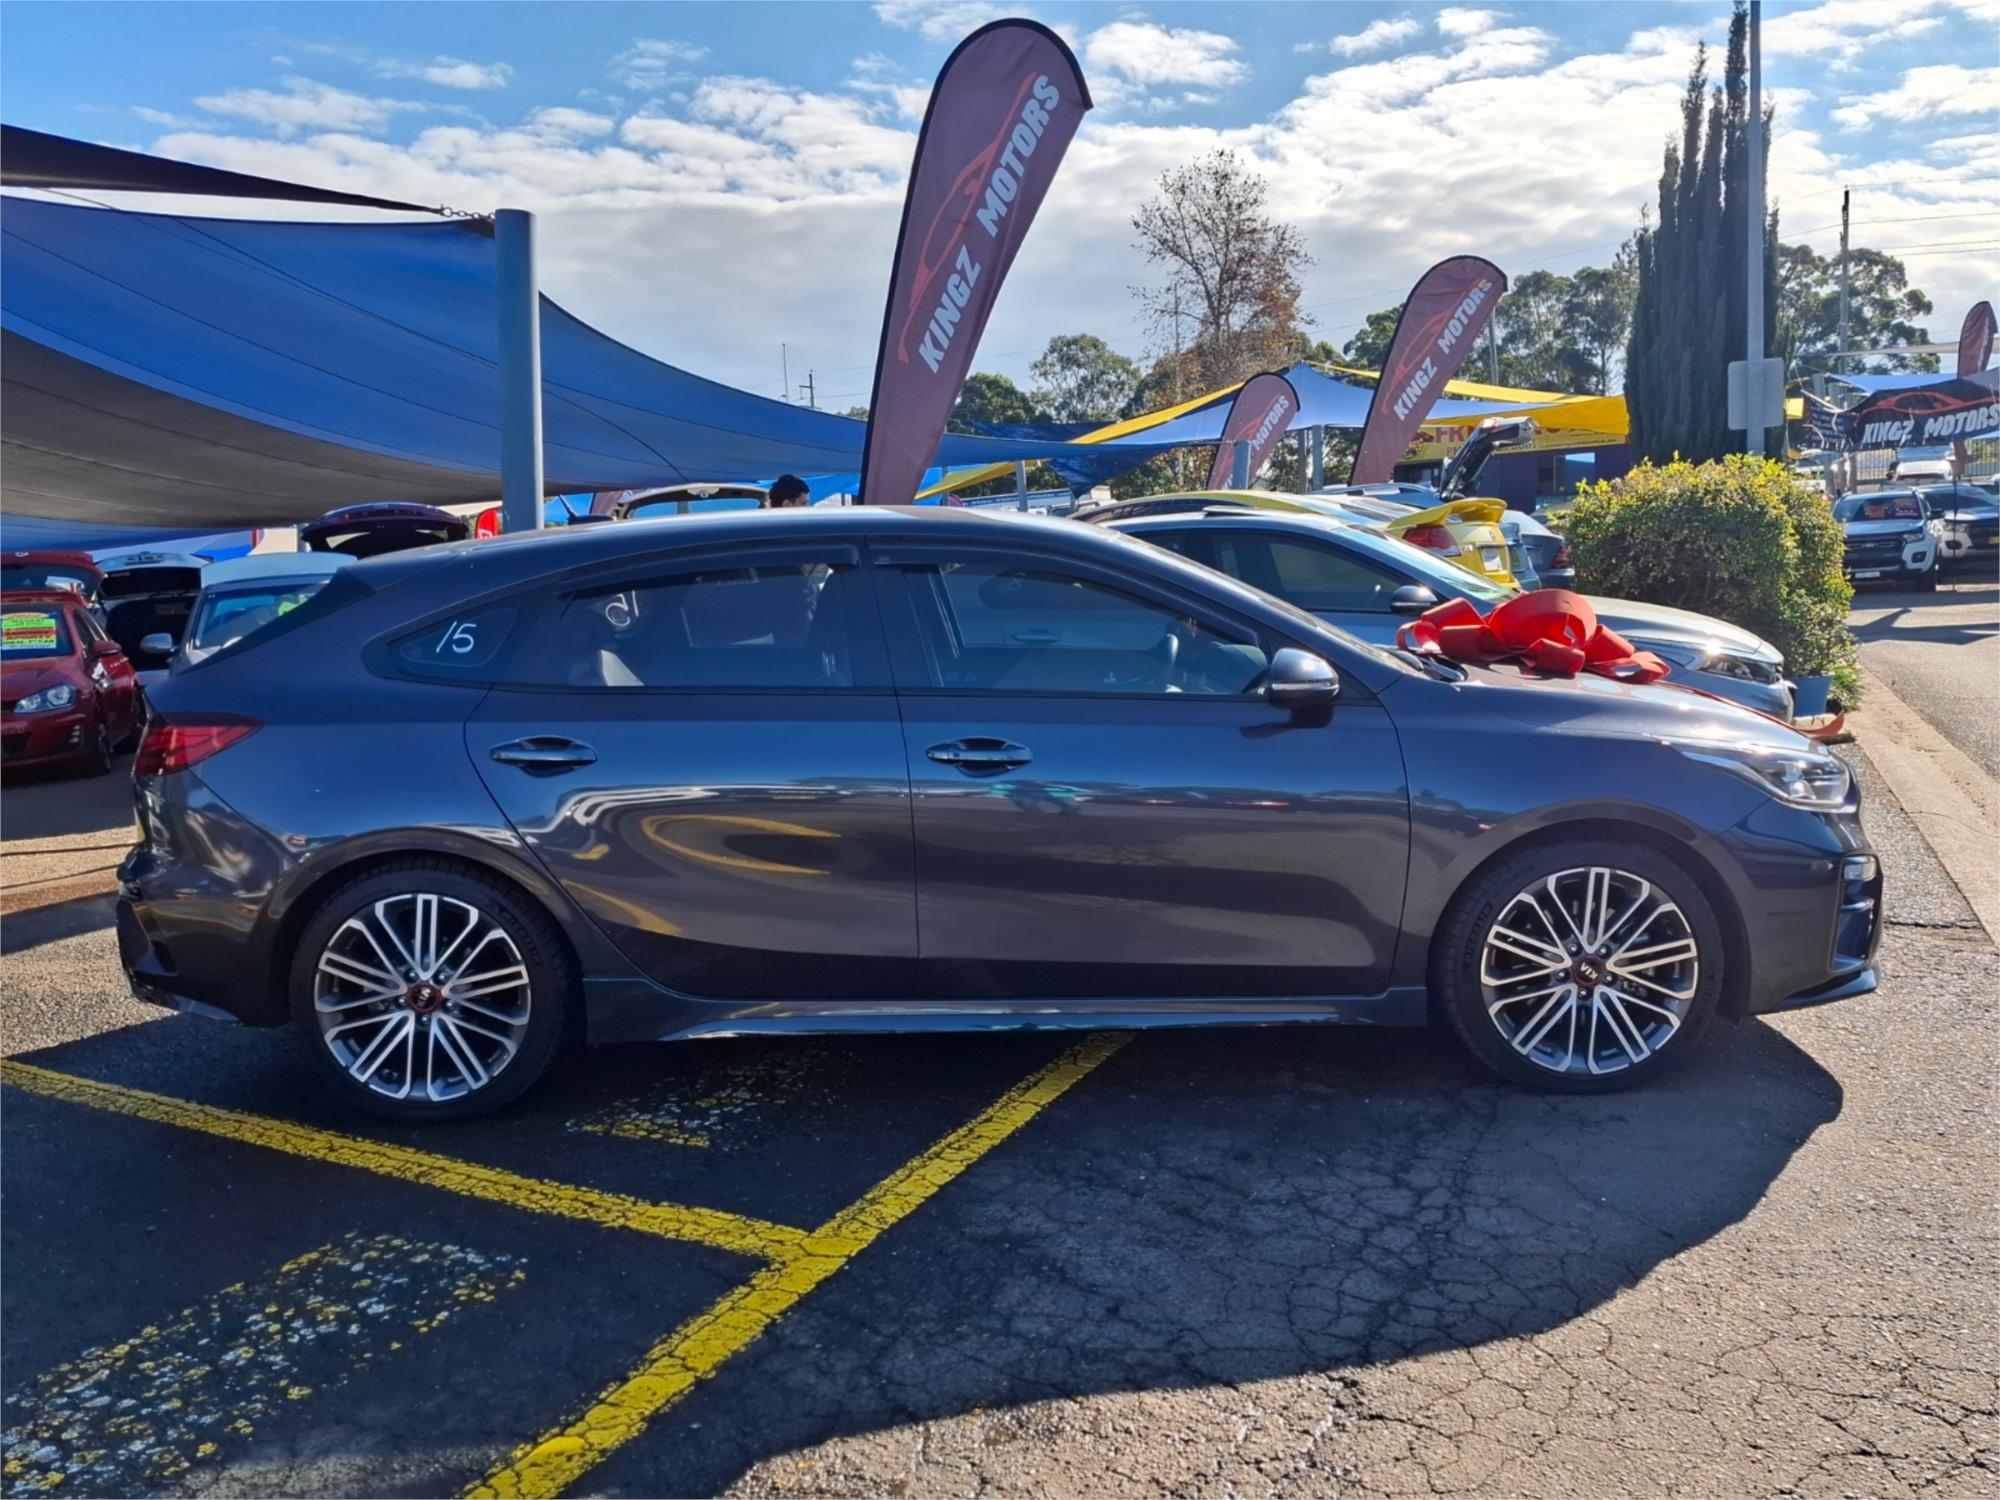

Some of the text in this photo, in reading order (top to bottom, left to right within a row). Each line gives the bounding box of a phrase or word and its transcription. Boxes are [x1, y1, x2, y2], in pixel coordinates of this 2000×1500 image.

[918, 75, 1061, 374] KINGZ MOTORS
[1393, 279, 1493, 421] KINGZ MOTORS
[1252, 395, 1290, 451] MOTORS
[1862, 421, 1913, 443] KINGZ
[1923, 404, 2000, 438] MOTORS
